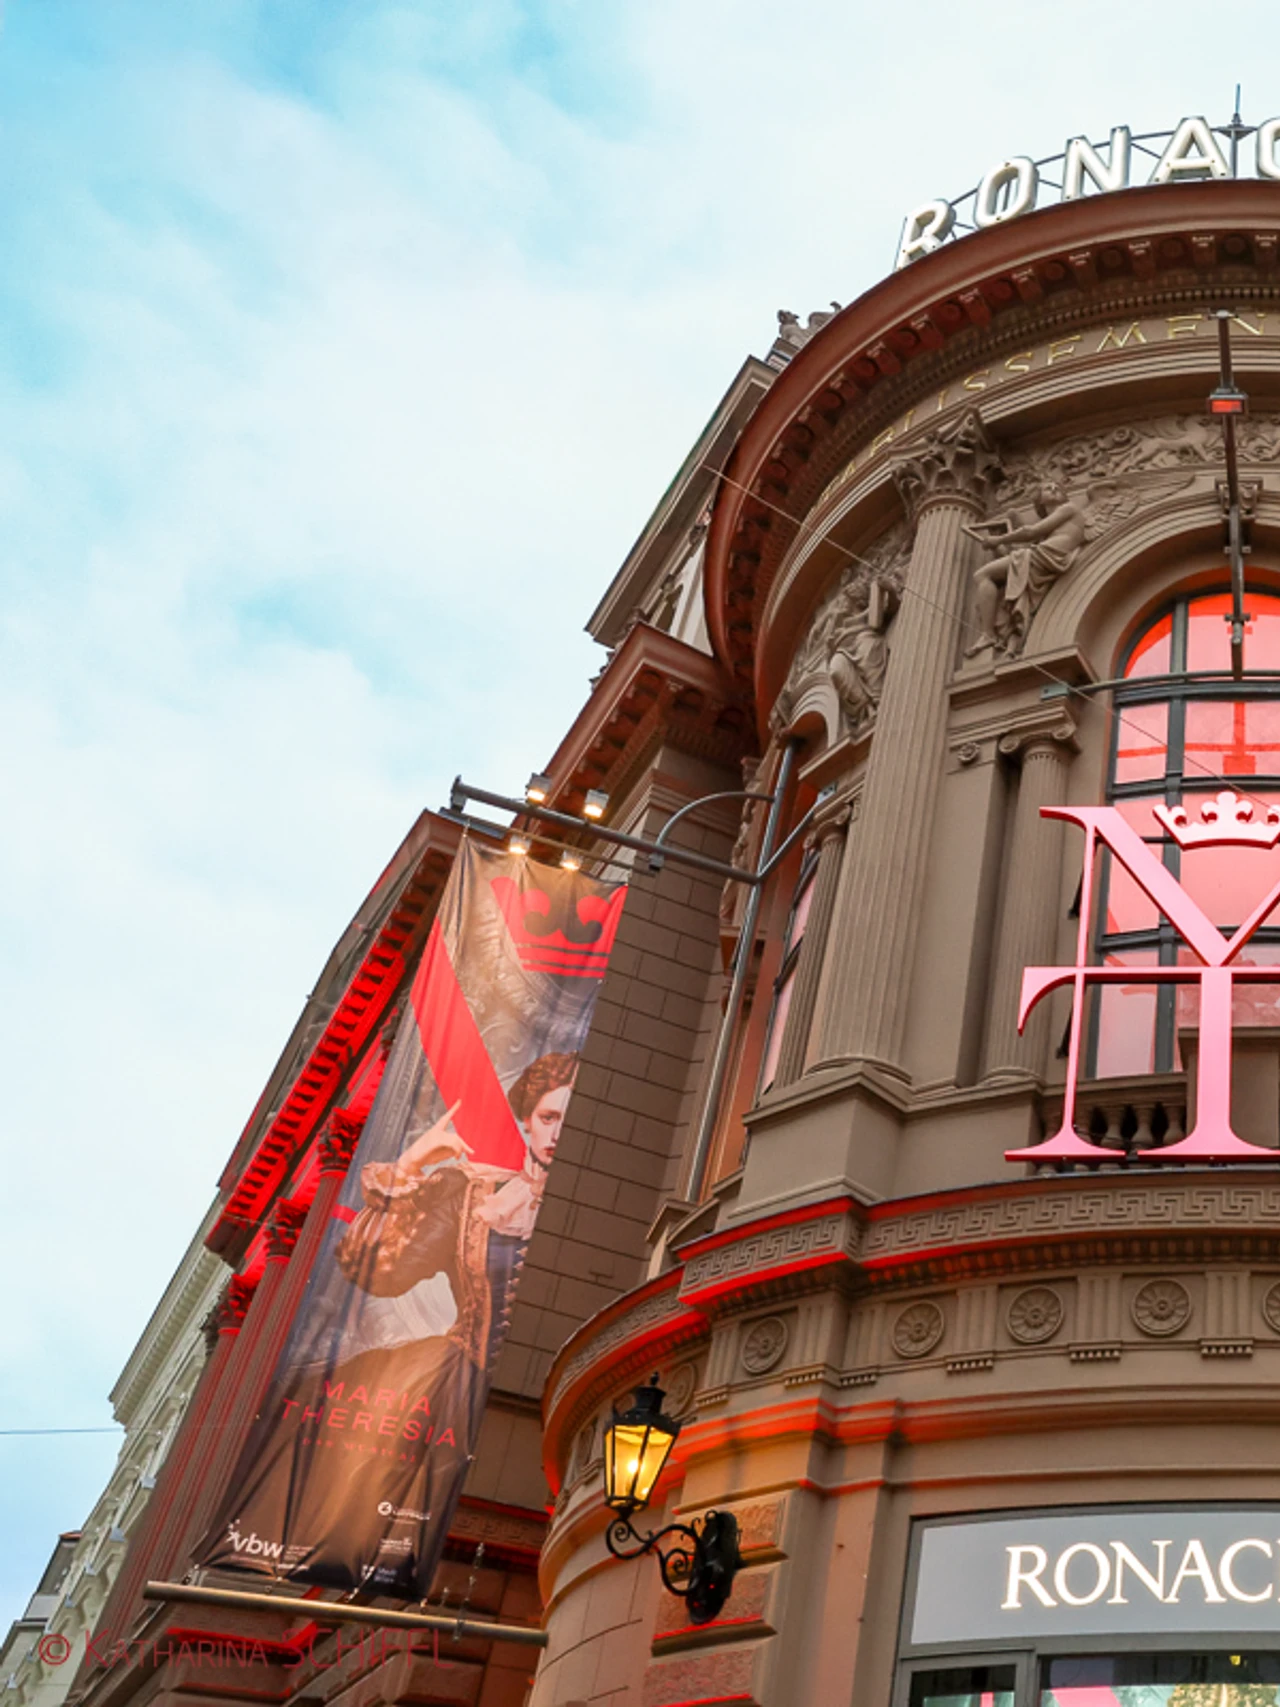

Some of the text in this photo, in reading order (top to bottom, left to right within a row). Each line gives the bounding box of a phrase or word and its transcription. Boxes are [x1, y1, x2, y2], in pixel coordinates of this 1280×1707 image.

[322, 1380, 432, 1417] MARIA
[280, 1398, 457, 1448] THERESIA
[231, 1531, 285, 1559] vbw
